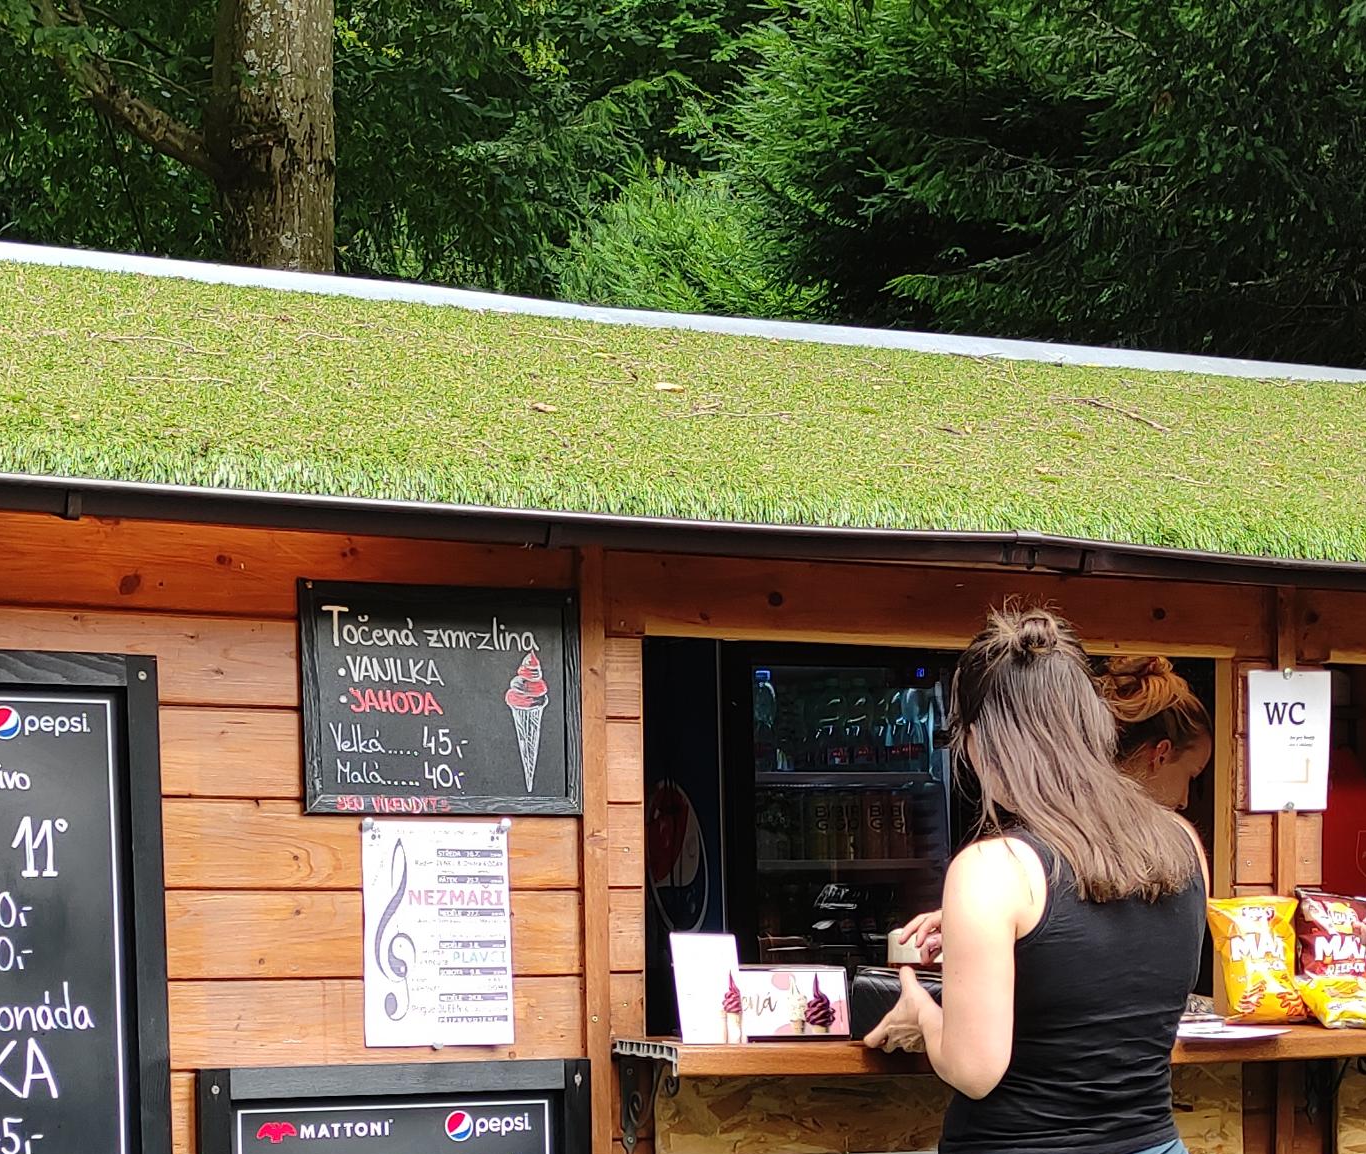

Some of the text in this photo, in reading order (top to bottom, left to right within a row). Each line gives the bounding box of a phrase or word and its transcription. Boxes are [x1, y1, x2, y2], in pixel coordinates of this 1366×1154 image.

[322, 605, 540, 651] Točená zmrzlina
[346, 655, 445, 686] VANILKA
[349, 688, 443, 715] JAHODA
[1264, 701, 1306, 725] WC
[24, 712, 88, 736] pepsi
[329, 723, 385, 753] Velká
[336, 758, 384, 784] Malá
[408, 884, 504, 906] NEZMAŘI
[299, 1112, 532, 1140] MATTONI pepsi
